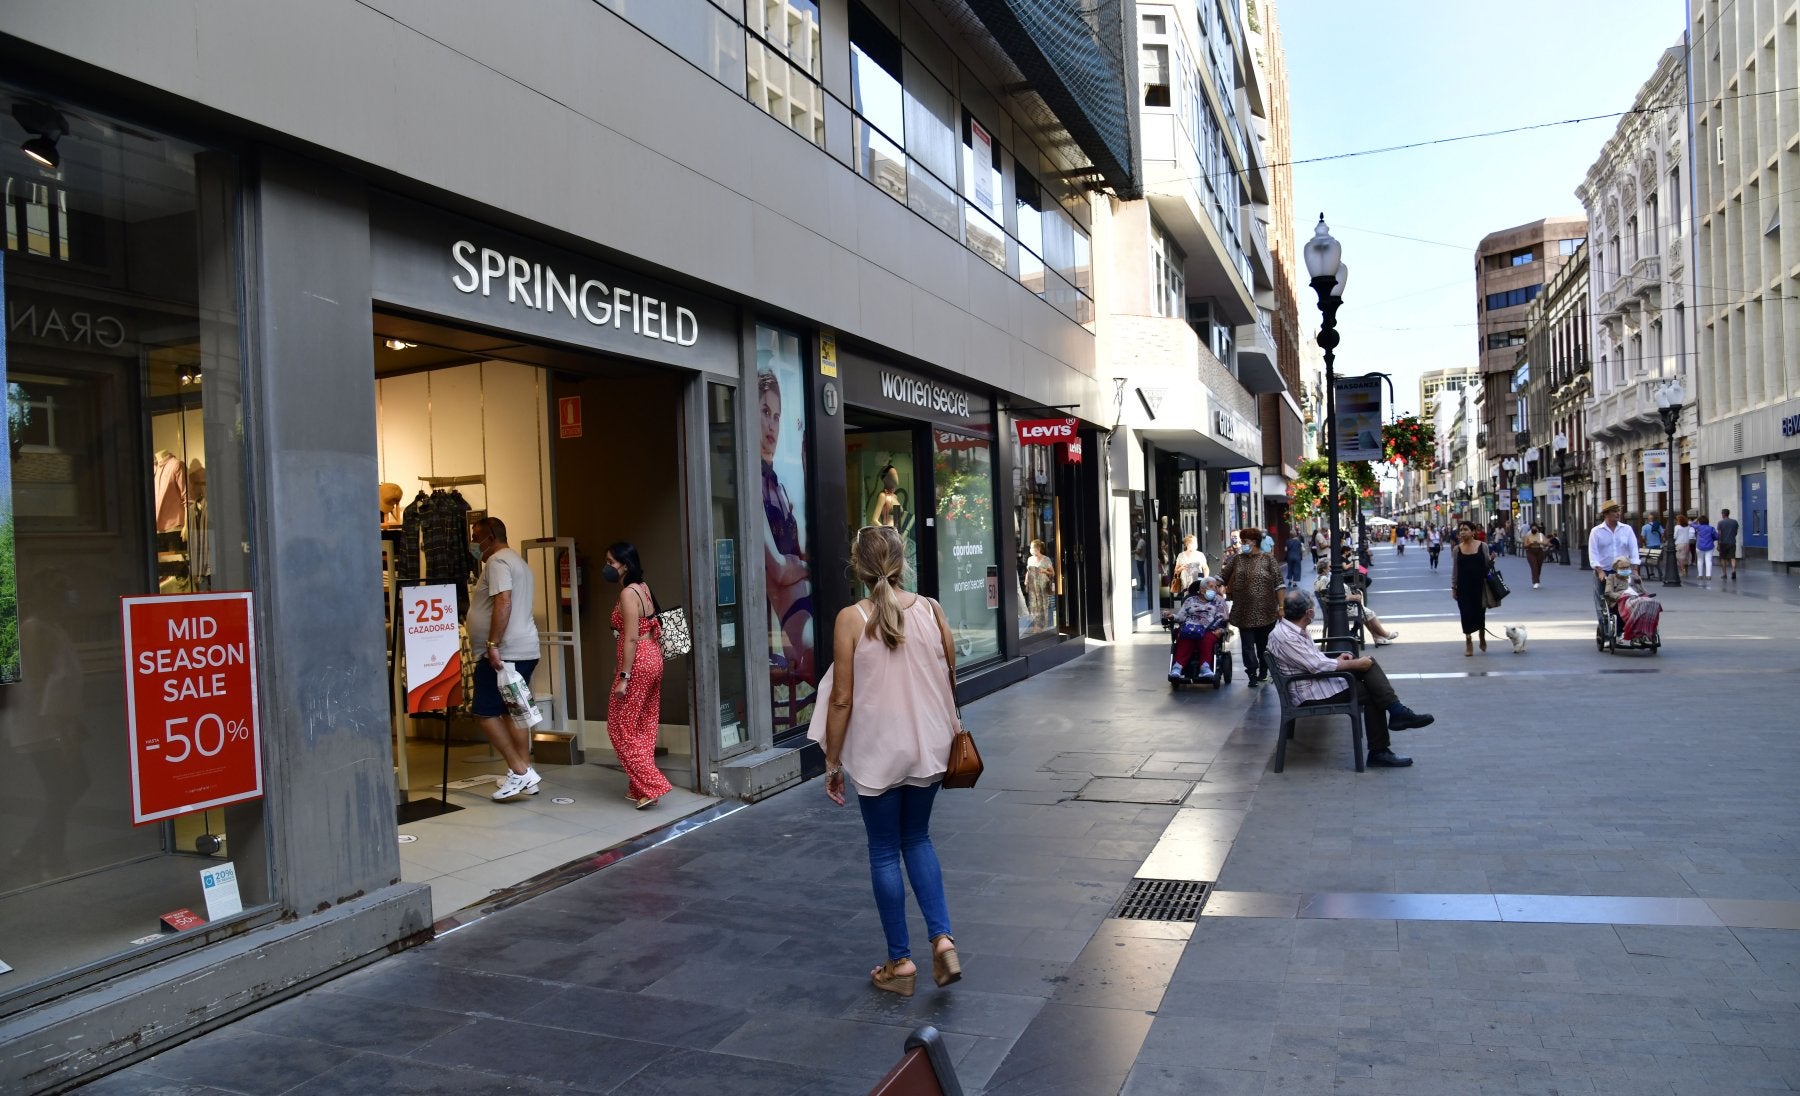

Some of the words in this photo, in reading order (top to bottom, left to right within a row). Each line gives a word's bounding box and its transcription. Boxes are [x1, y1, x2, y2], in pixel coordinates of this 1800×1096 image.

[452, 239, 699, 347] SPRINGFIELD
[880, 370, 970, 418] women'secret
[1336, 382, 1379, 391] MASDANZA
[408, 598, 453, 623] -25%
[168, 616, 217, 641] MID
[408, 623, 455, 635] CAZADORAS
[139, 642, 244, 674] SEASON
[163, 673, 226, 702] SALE
[145, 713, 249, 763] -50%
